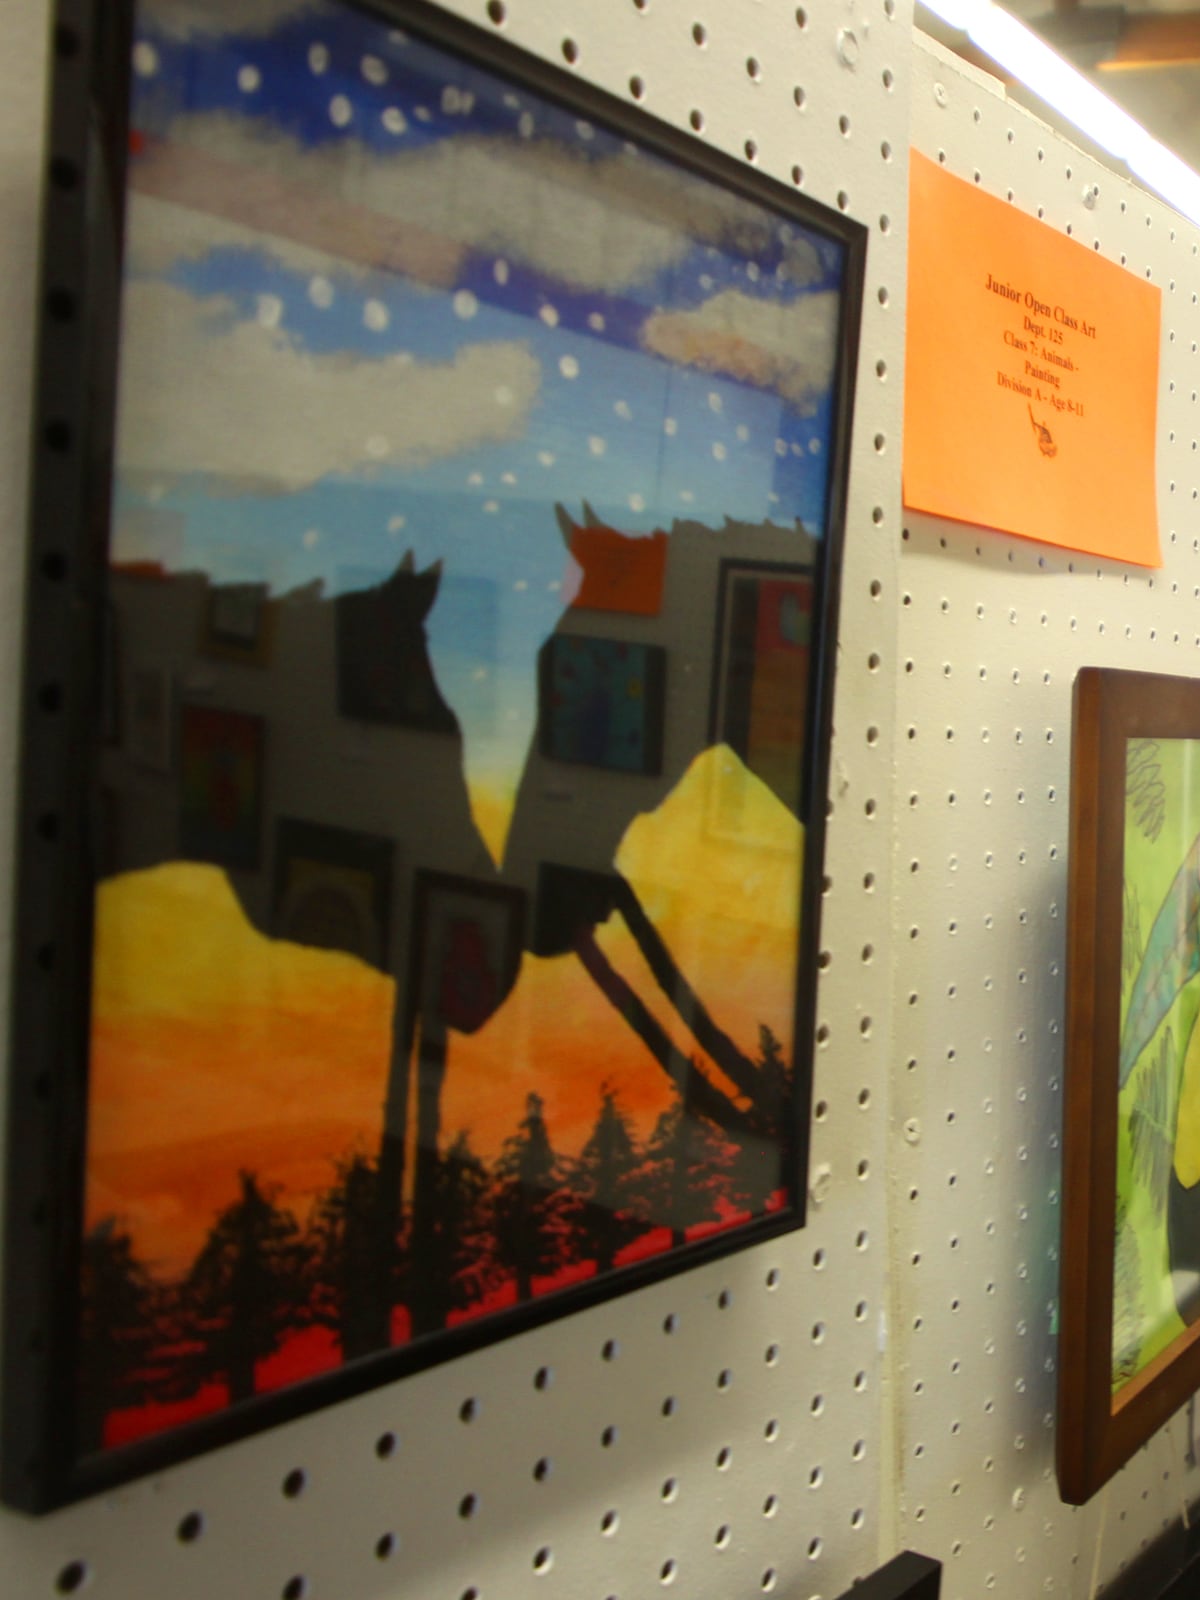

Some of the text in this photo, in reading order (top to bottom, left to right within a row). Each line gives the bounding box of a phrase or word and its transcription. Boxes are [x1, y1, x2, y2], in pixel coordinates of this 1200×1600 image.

[985, 273, 1096, 339] Junior Open Class Art
[1023, 315, 1063, 345] Dept. 125
[1003, 329, 1028, 351] Class
[1041, 346, 1073, 371] Animals
[997, 370, 1032, 397] Division
[1035, 387, 1042, 401] A
[1024, 360, 1060, 389] Painting
